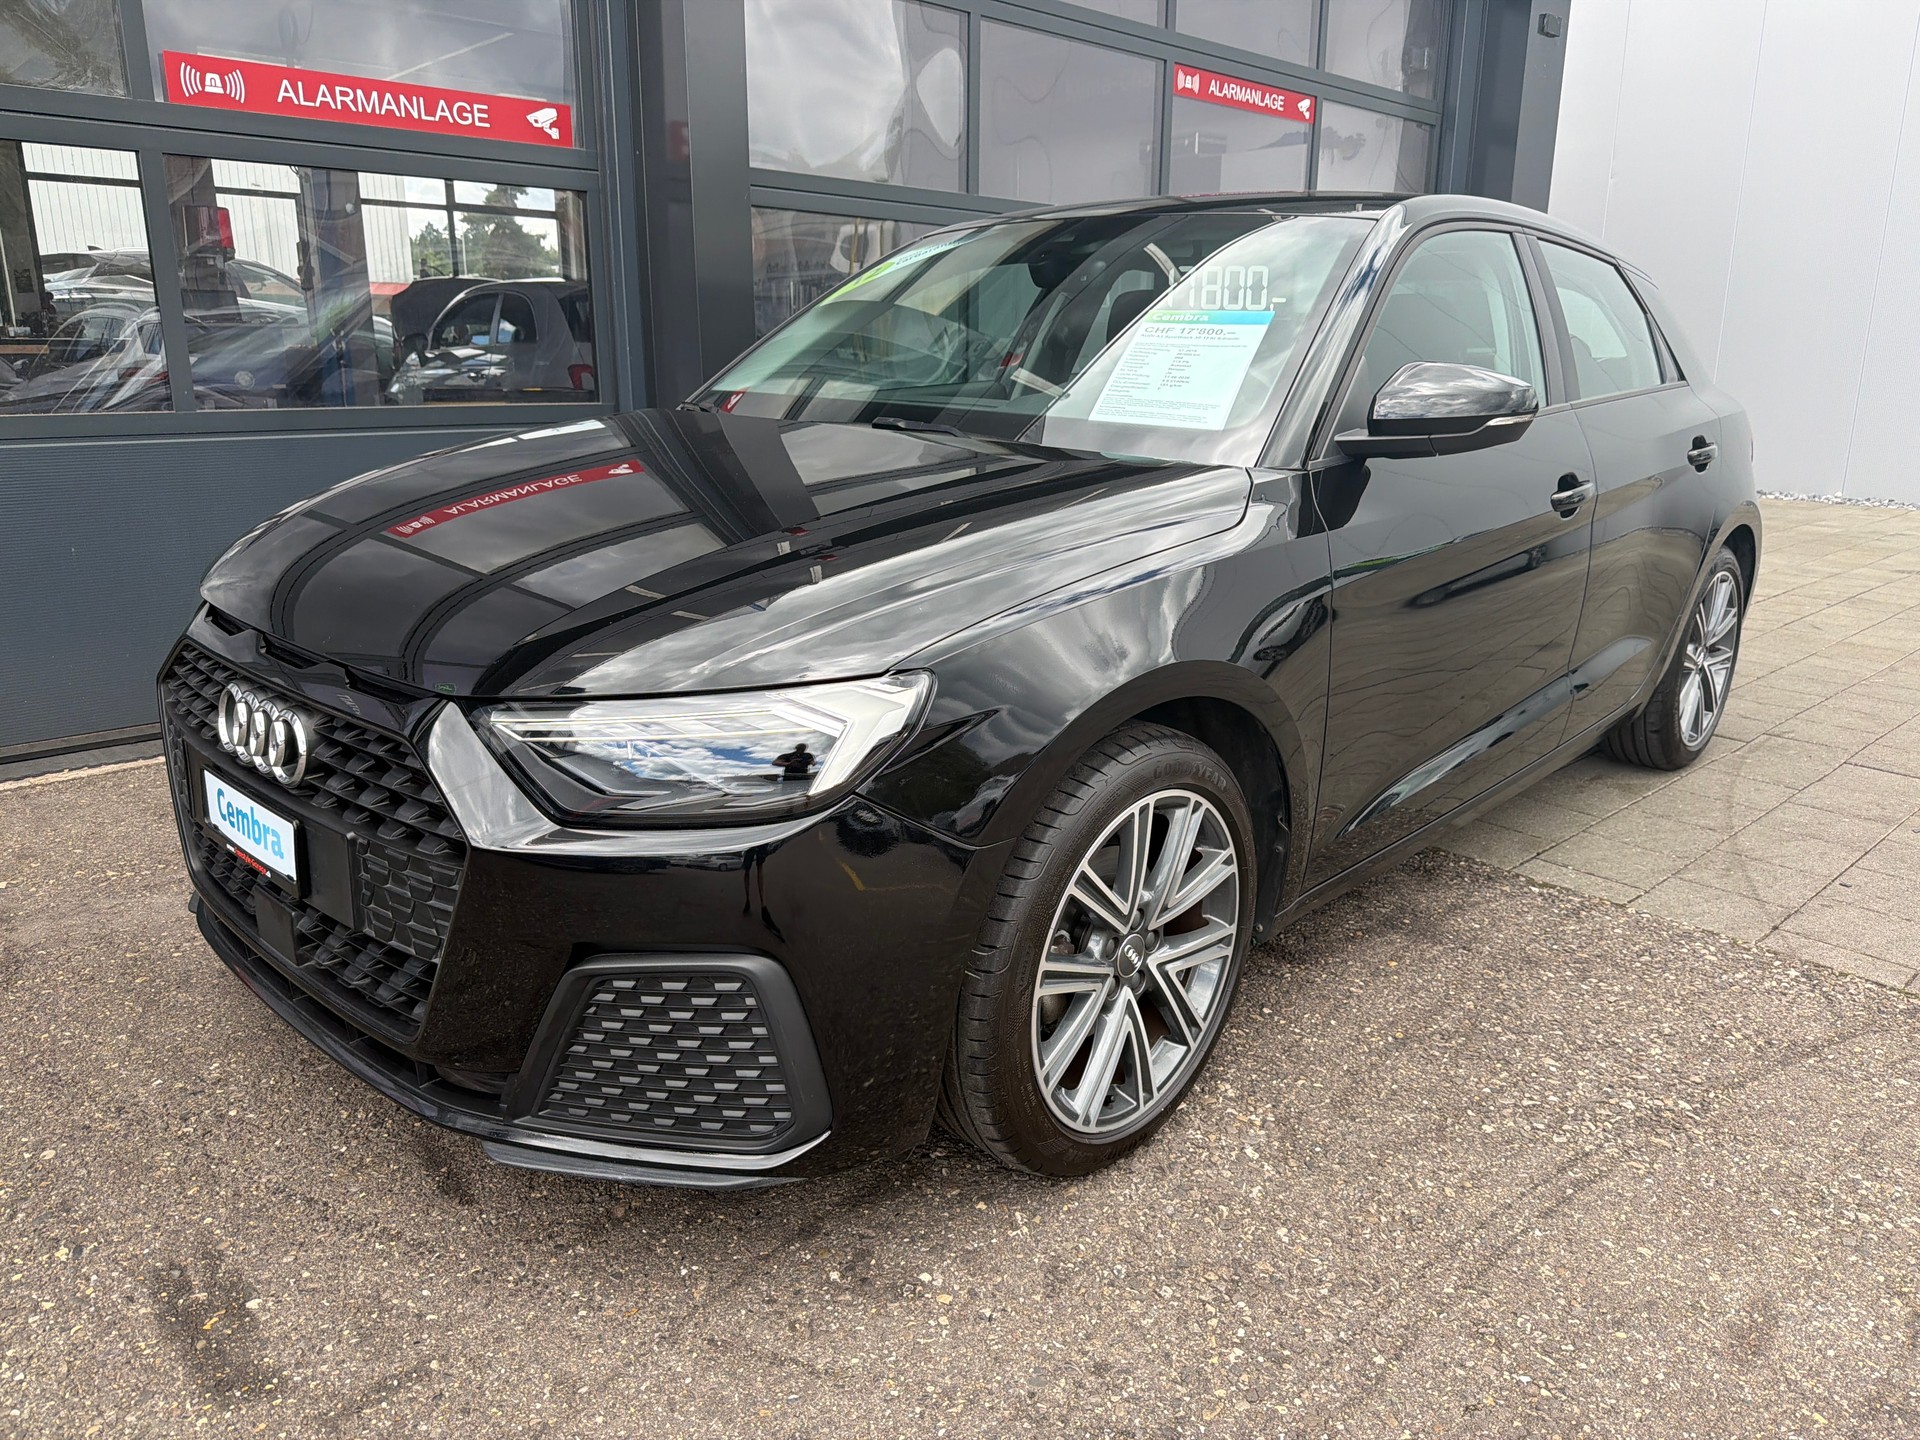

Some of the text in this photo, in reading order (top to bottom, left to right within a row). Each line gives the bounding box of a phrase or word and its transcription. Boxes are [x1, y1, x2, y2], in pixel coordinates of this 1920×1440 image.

[277, 78, 490, 127] ALARMANLAGE
[1208, 79, 1285, 111] ALARMANLAGE
[1145, 326, 1176, 334] CHF
[1152, 313, 1209, 321] Cembra
[1153, 760, 1227, 791] GOODYEAR
[217, 787, 285, 860] Cembra
